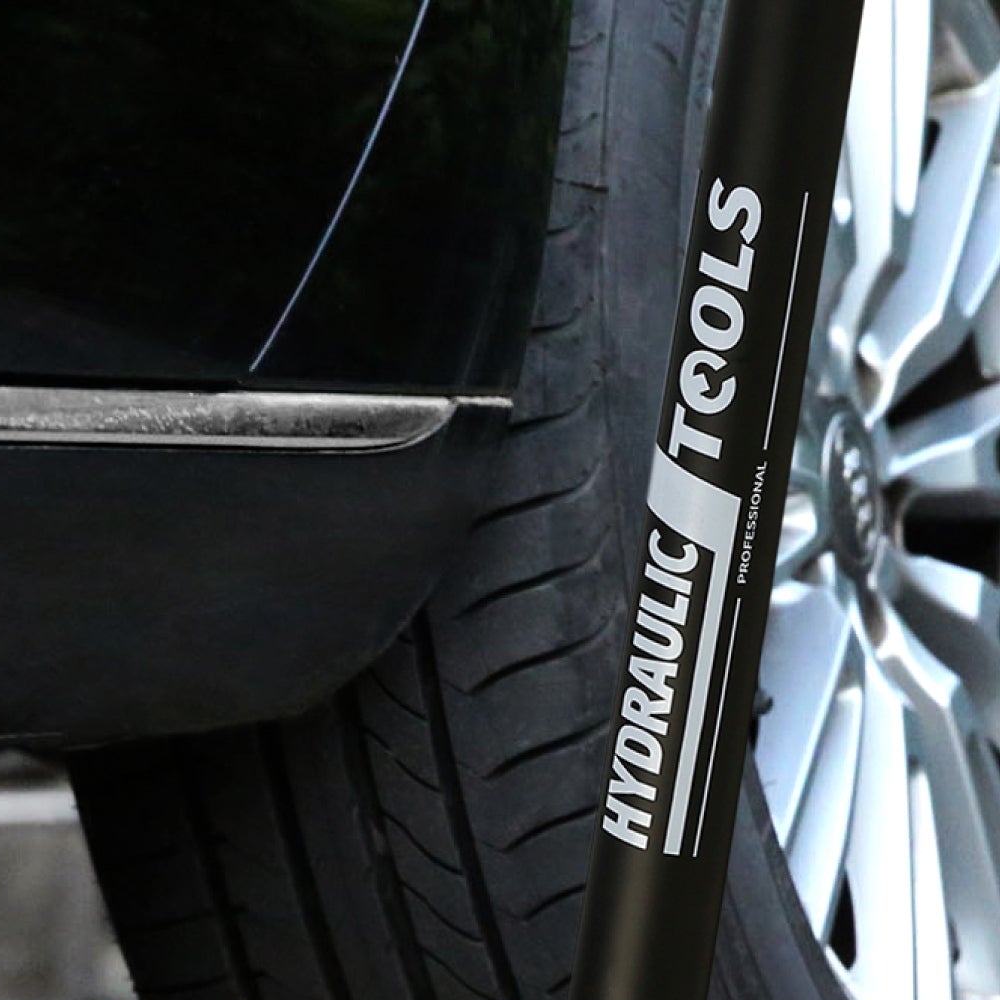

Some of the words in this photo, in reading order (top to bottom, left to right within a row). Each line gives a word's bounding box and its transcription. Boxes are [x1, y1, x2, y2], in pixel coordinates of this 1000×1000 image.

[602, 528, 698, 850] HYDRAULIC
[668, 177, 762, 460] TOOLS
[737, 460, 768, 585] PROFESSIONAL
